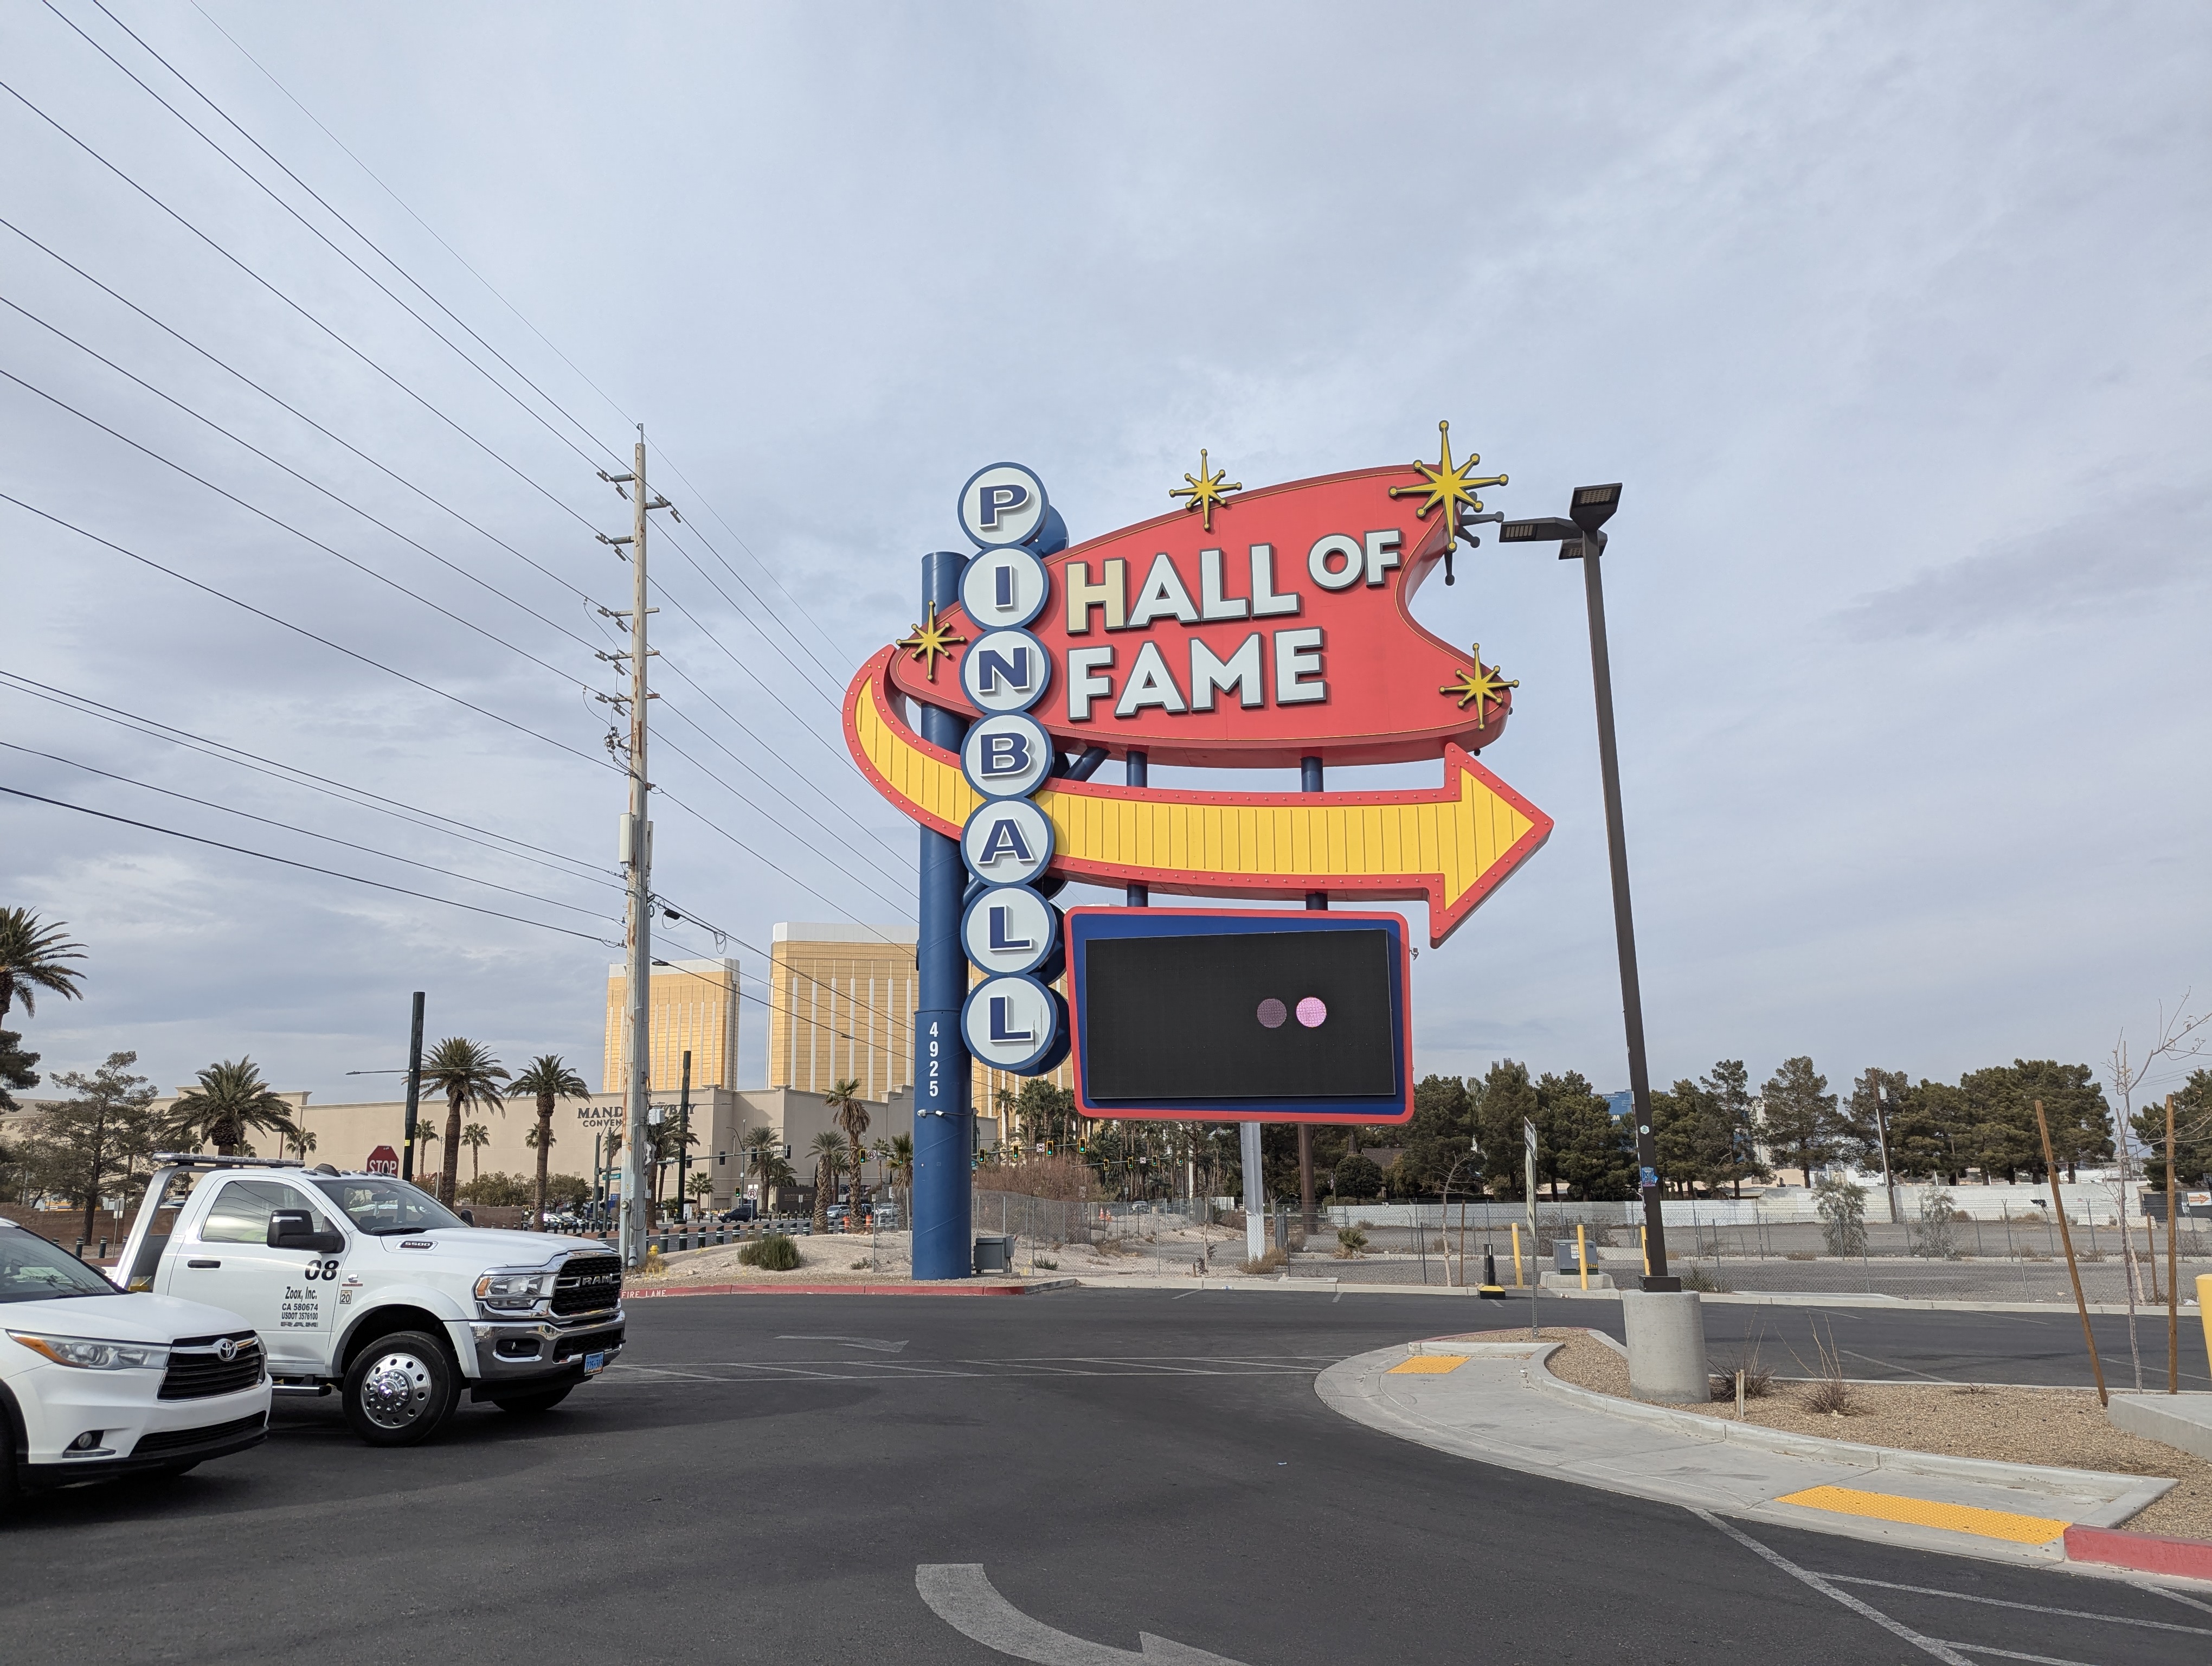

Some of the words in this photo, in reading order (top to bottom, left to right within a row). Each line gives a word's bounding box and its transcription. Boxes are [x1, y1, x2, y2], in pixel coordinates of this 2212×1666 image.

[1065, 542, 1301, 634] HALL
[1307, 528, 1402, 590] OF
[1066, 626, 1327, 721] FAME
[975, 483, 1035, 1043] PINBALL
[929, 1021, 938, 1097] 4925
[369, 1159, 397, 1174] STOP
[305, 1259, 339, 1281] 08
[582, 1275, 613, 1286] RAM
[285, 1286, 304, 1302] Zoox,
[305, 1286, 318, 1299] Inc.
[340, 1293, 350, 1303] 20
[645, 1290, 667, 1298] LANE
[298, 1312, 318, 1320] 3576100
